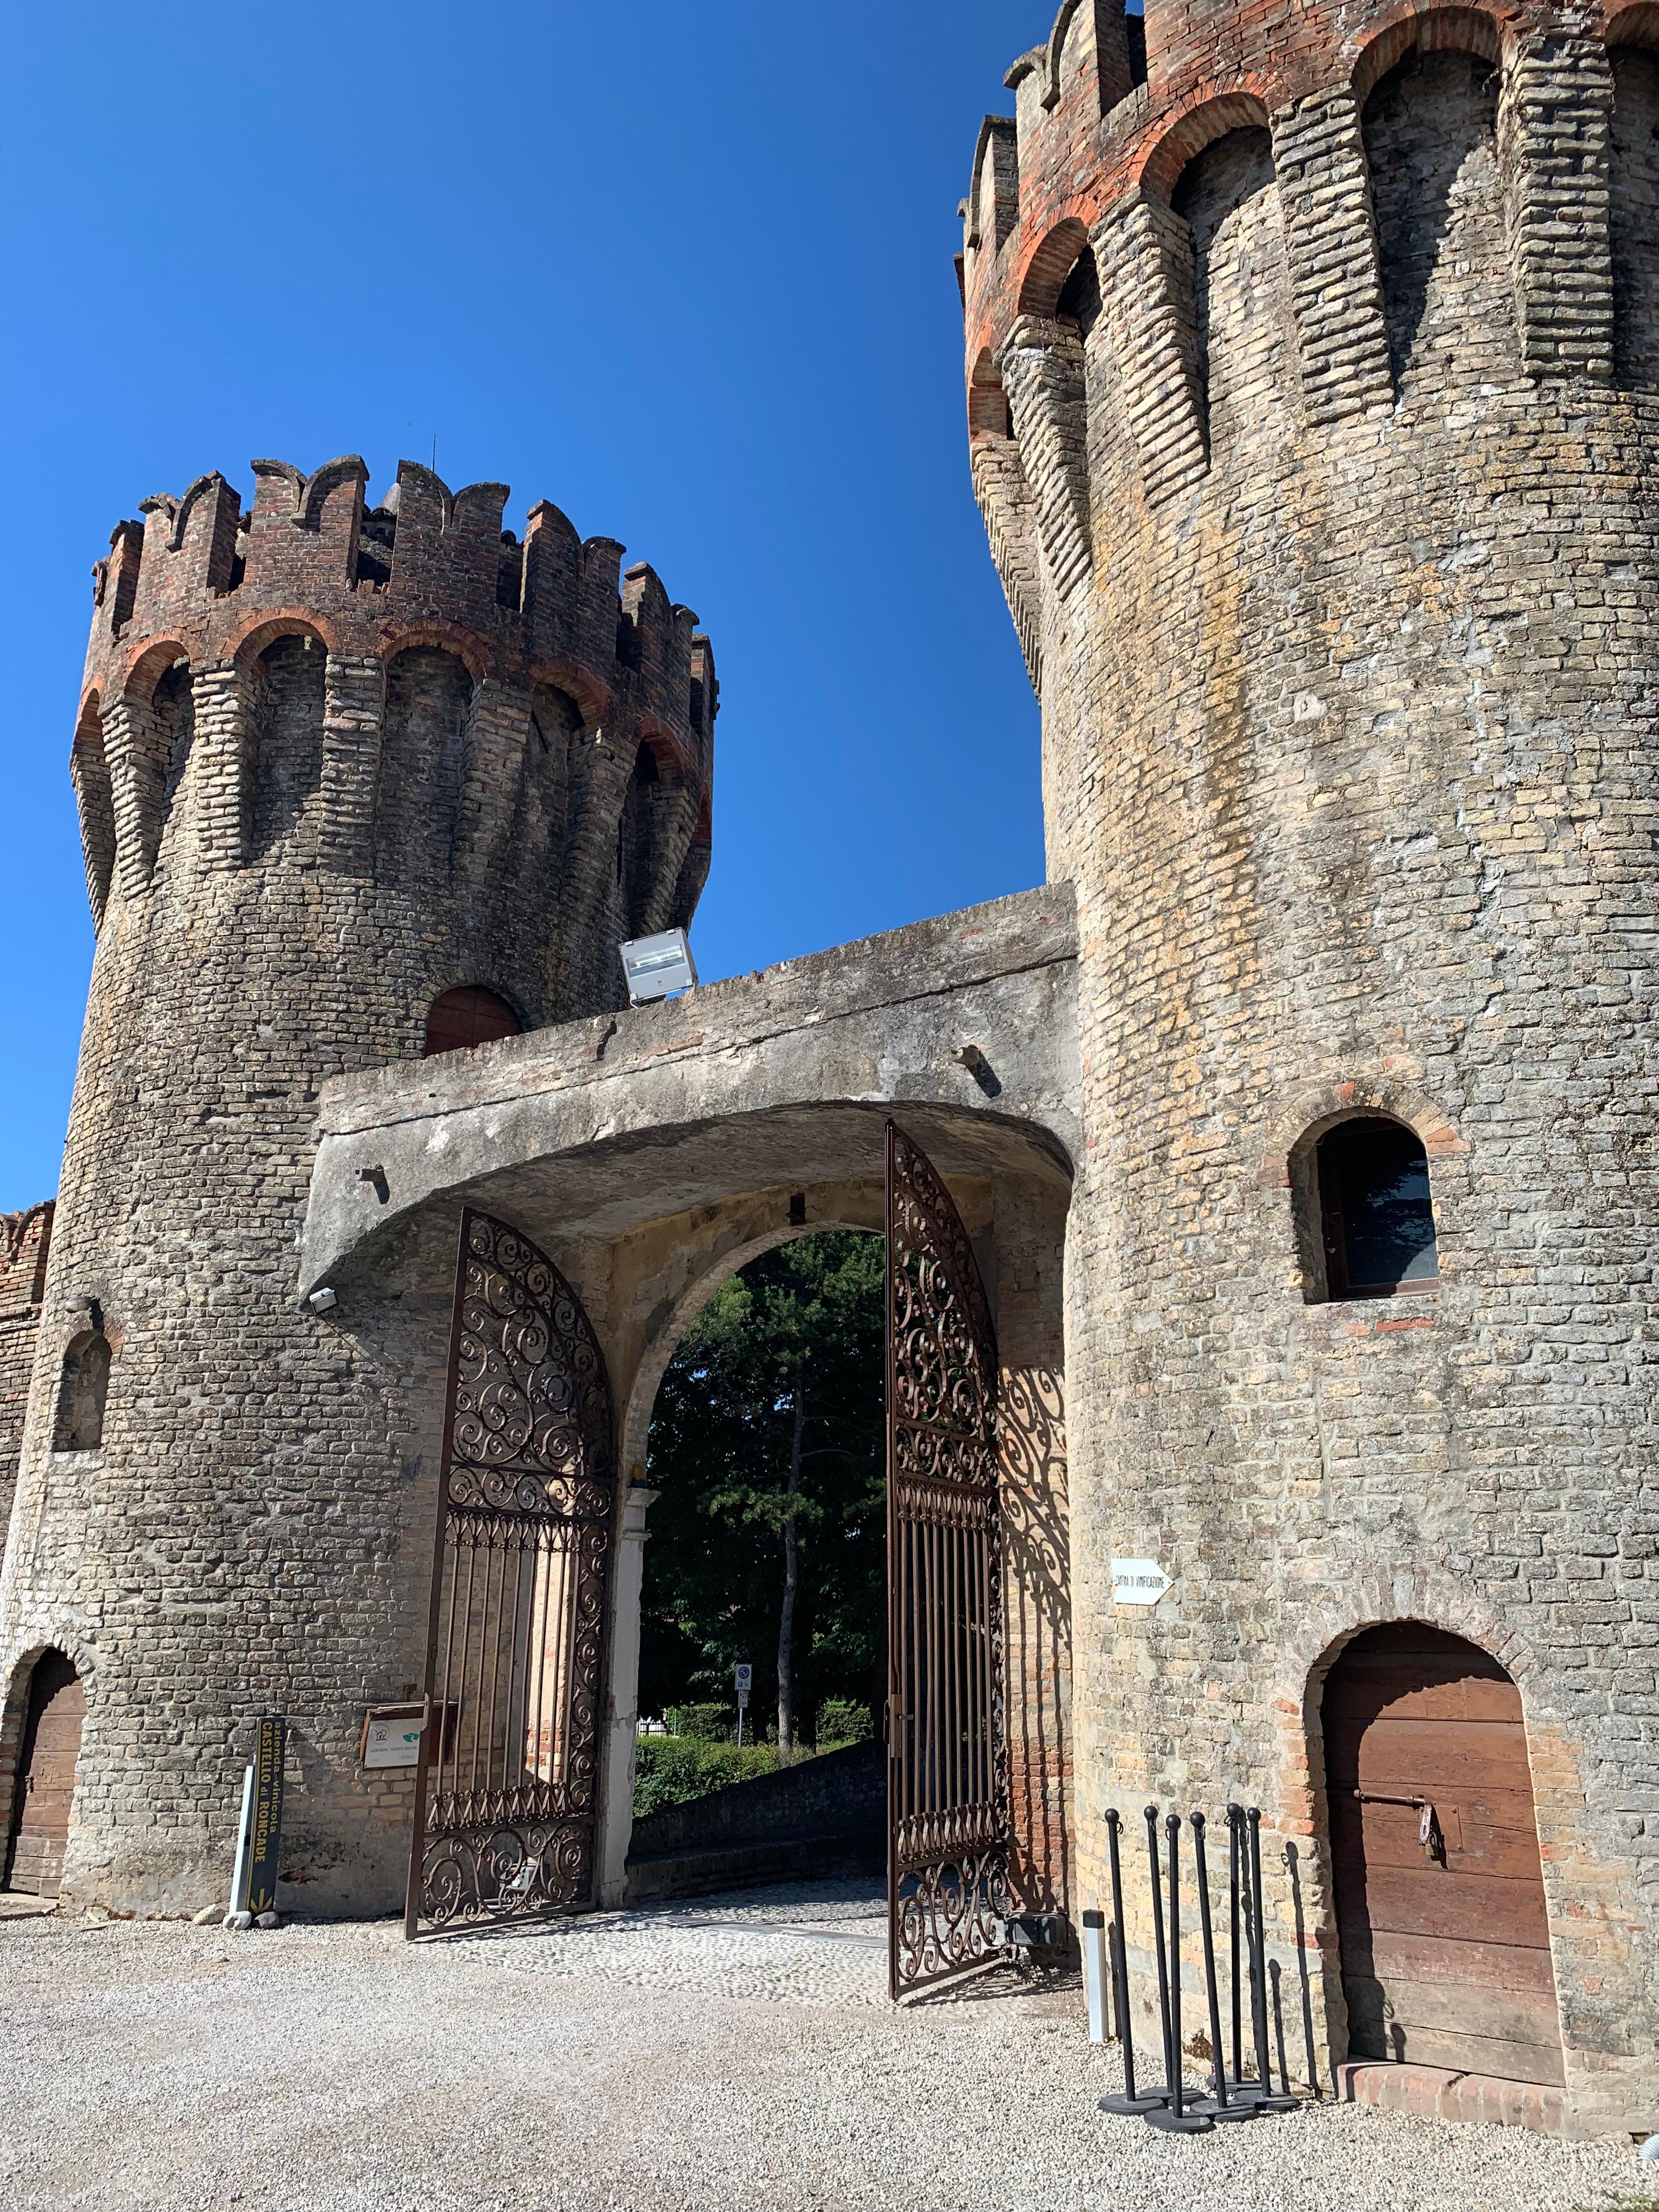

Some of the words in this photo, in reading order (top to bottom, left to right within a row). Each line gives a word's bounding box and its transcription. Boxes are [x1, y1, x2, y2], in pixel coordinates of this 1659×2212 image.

[261, 1722, 273, 1783] CASTELLO
[274, 1722, 283, 1773] azienda
[260, 1786, 268, 1796] di
[270, 1780, 280, 1833] vinicola
[255, 1801, 269, 1863] RONCADE
